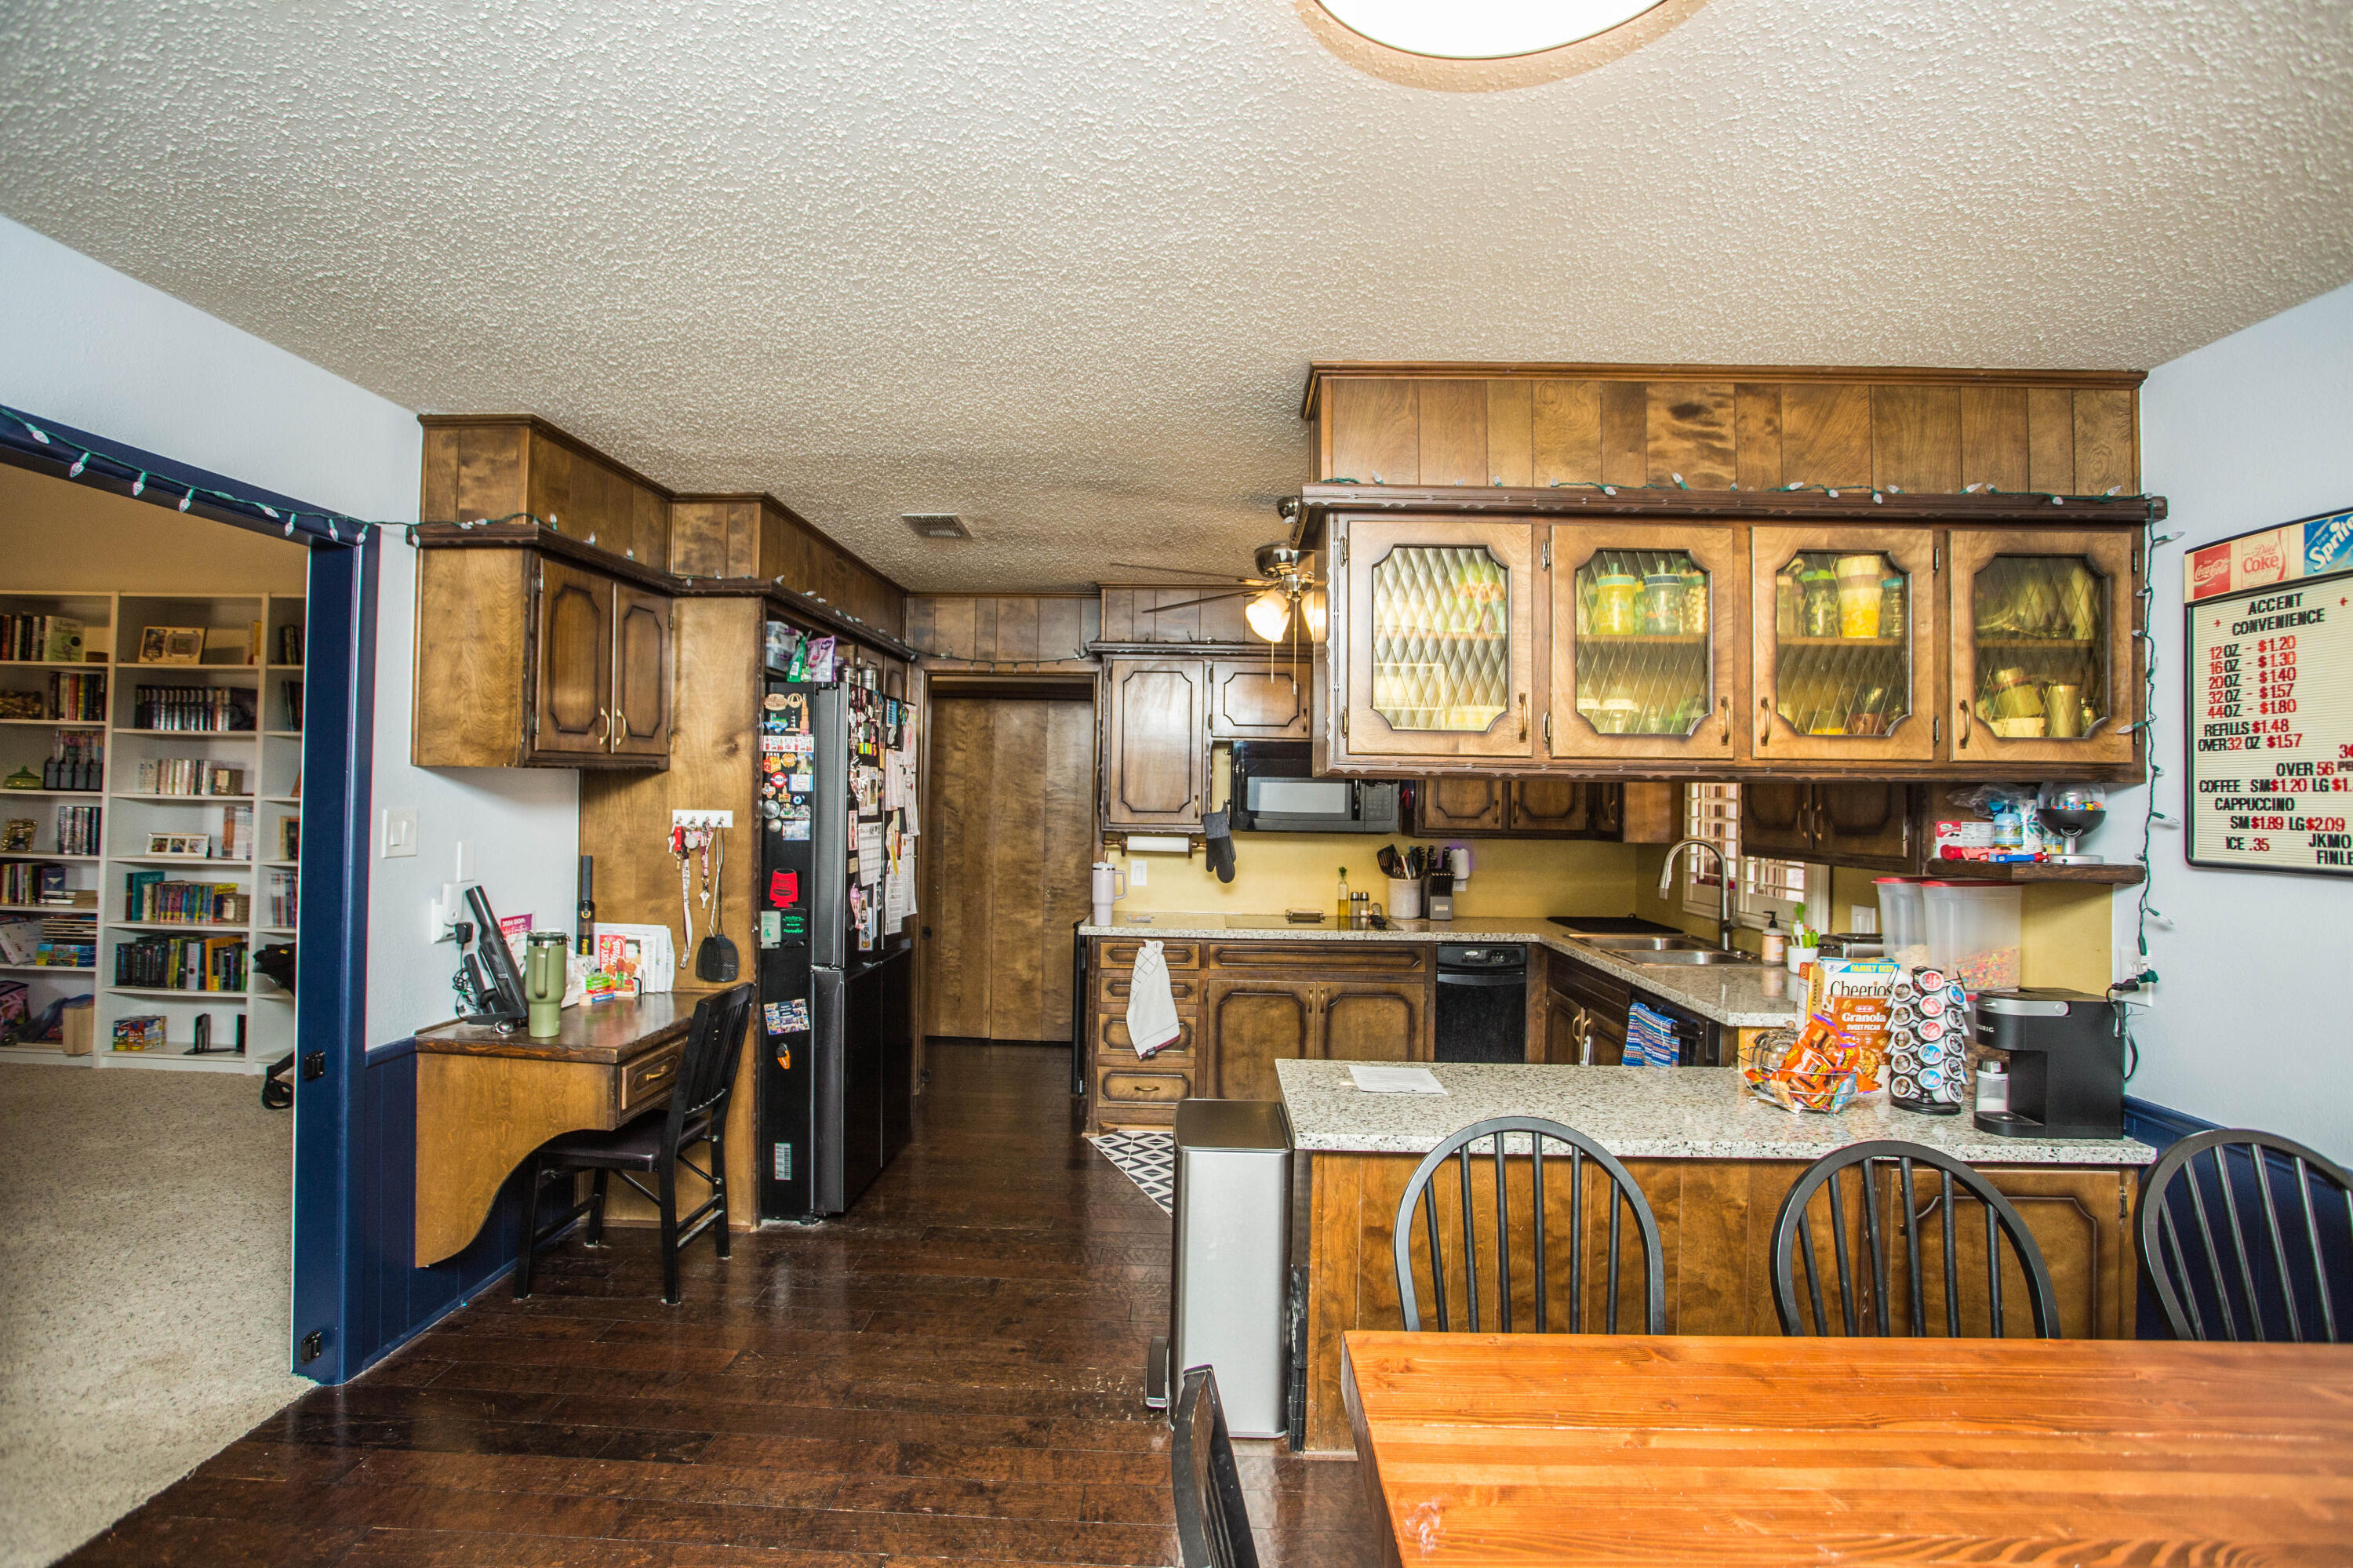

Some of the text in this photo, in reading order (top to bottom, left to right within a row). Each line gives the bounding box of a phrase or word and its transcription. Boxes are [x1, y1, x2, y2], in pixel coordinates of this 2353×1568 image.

[2308, 515, 2353, 570] Sprite
[2242, 555, 2279, 574] Coke
[2247, 592, 2304, 616] ACCENT
[2231, 608, 2326, 636] CONVENIENCE
[2257, 635, 2297, 653] $1.20
[2257, 650, 2297, 668] $1.30
[2259, 667, 2297, 684] $1.40
[2204, 718, 2289, 737] REFILLS $1.48
[2245, 735, 2260, 750] OZ
[2267, 733, 2303, 749] $1.57
[2276, 762, 2314, 777] OVER
[2316, 761, 2335, 776] 56
[2199, 779, 2241, 793] COFFEE
[2311, 777, 2329, 793] LG
[2331, 777, 2353, 792] $1.
[2214, 797, 2296, 812] CAPPUCCINO
[2225, 836, 2245, 851] ICE
[1830, 980, 1893, 996] Cheerios
[1841, 1012, 1886, 1023] Granola
[1976, 1023, 1995, 1033] EURIG
